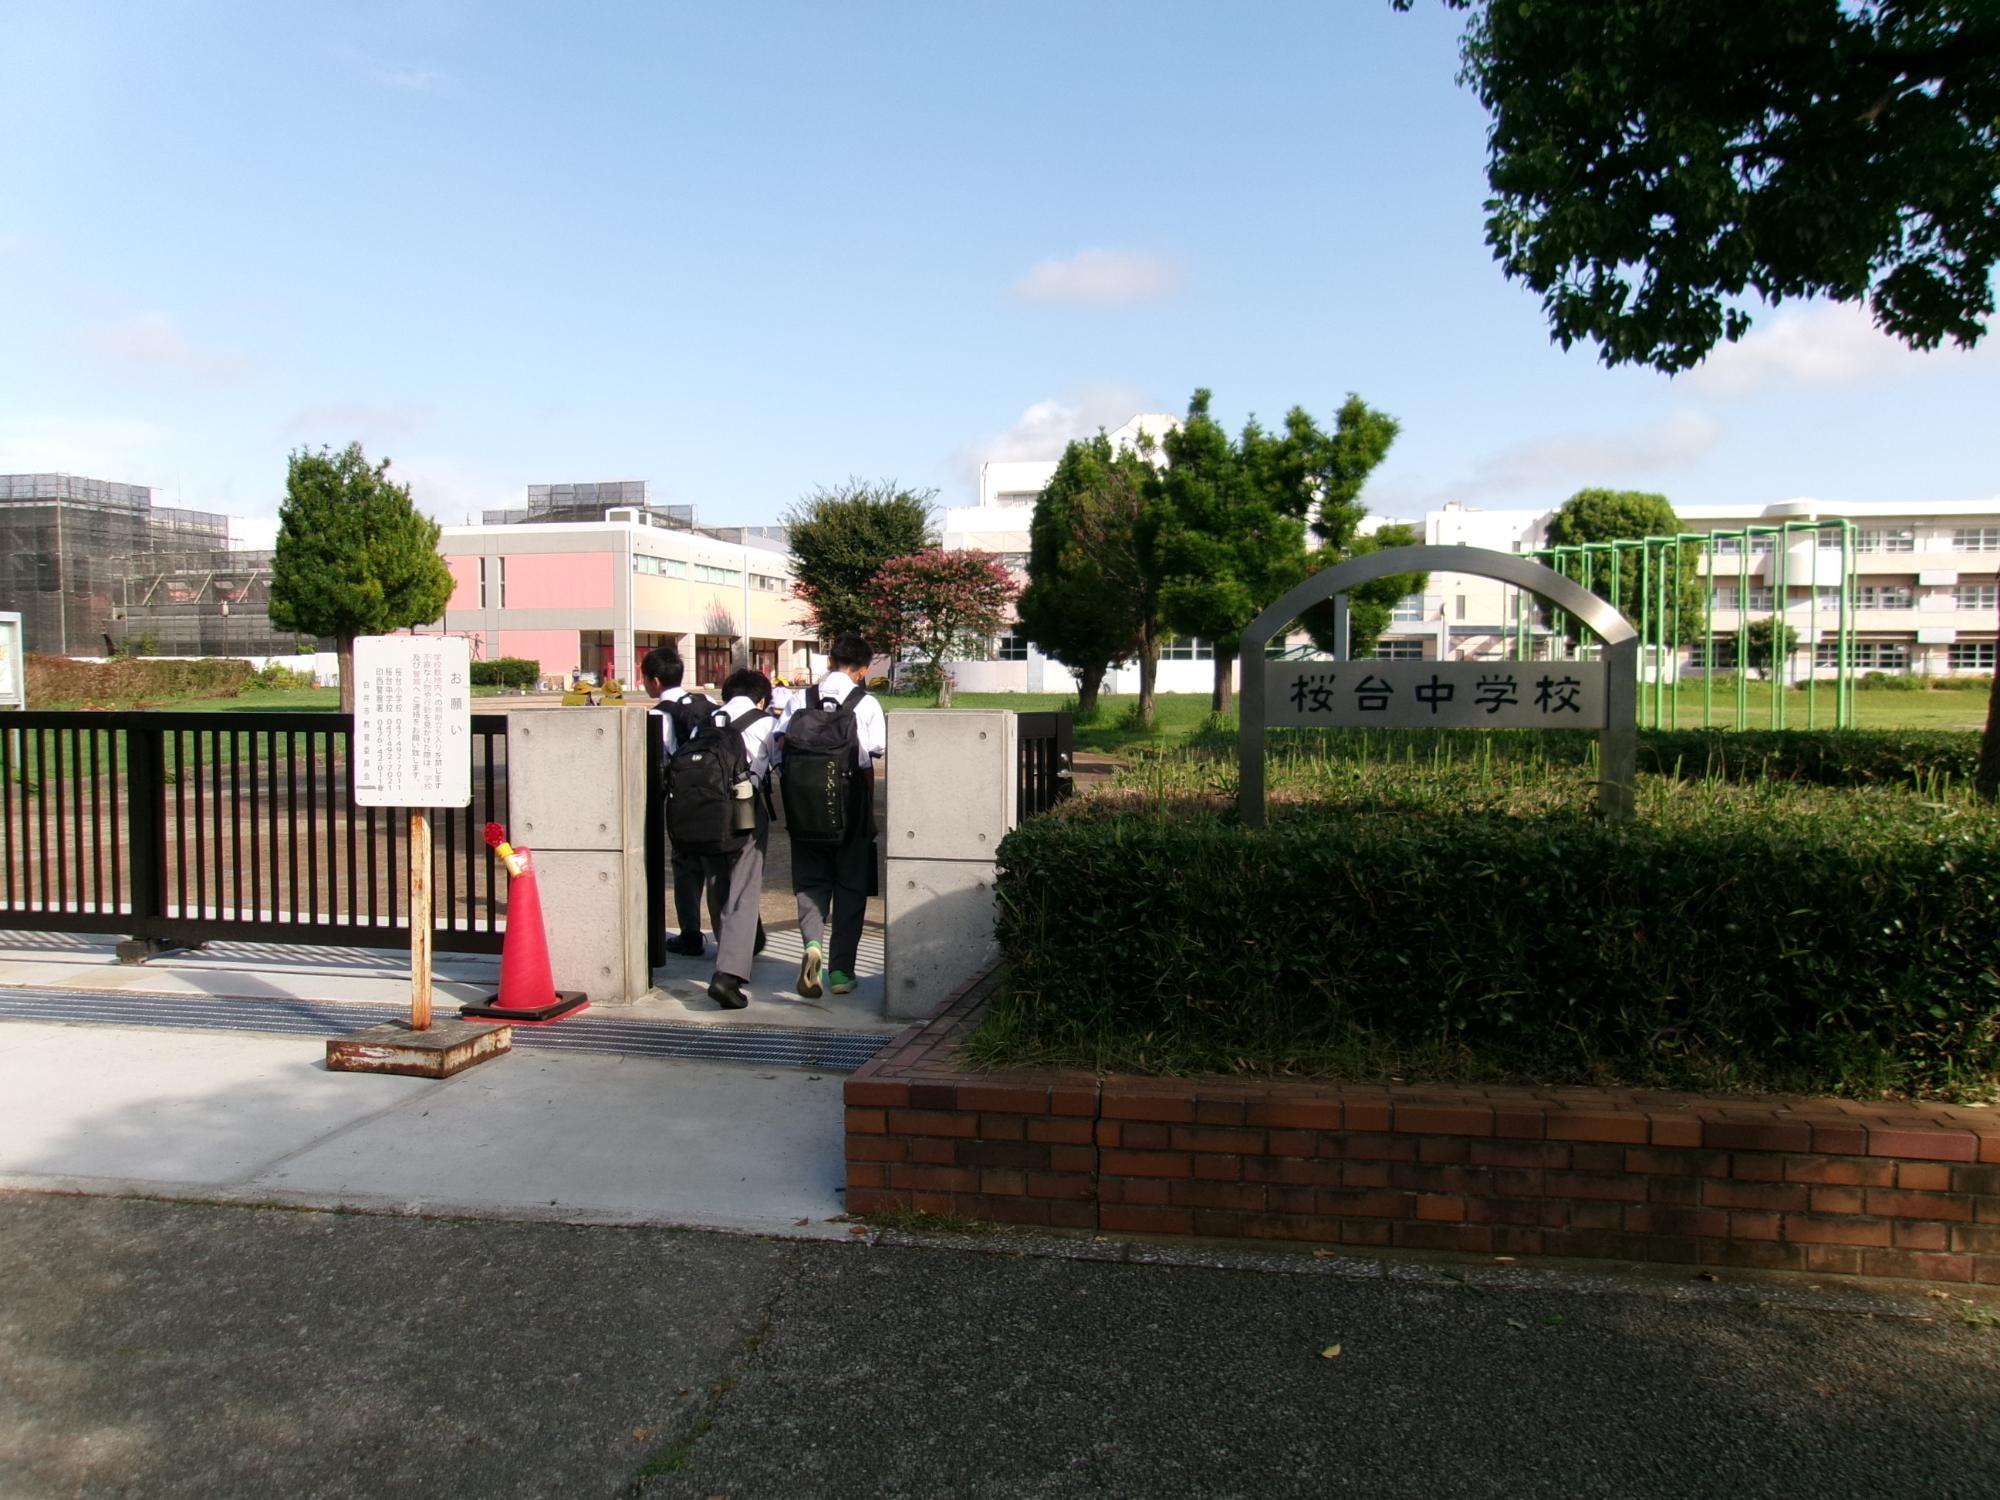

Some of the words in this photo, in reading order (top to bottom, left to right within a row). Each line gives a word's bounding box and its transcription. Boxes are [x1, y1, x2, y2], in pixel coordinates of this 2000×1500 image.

[450, 672, 462, 736] お願い
[1290, 673, 1581, 714] 桜台中学校
